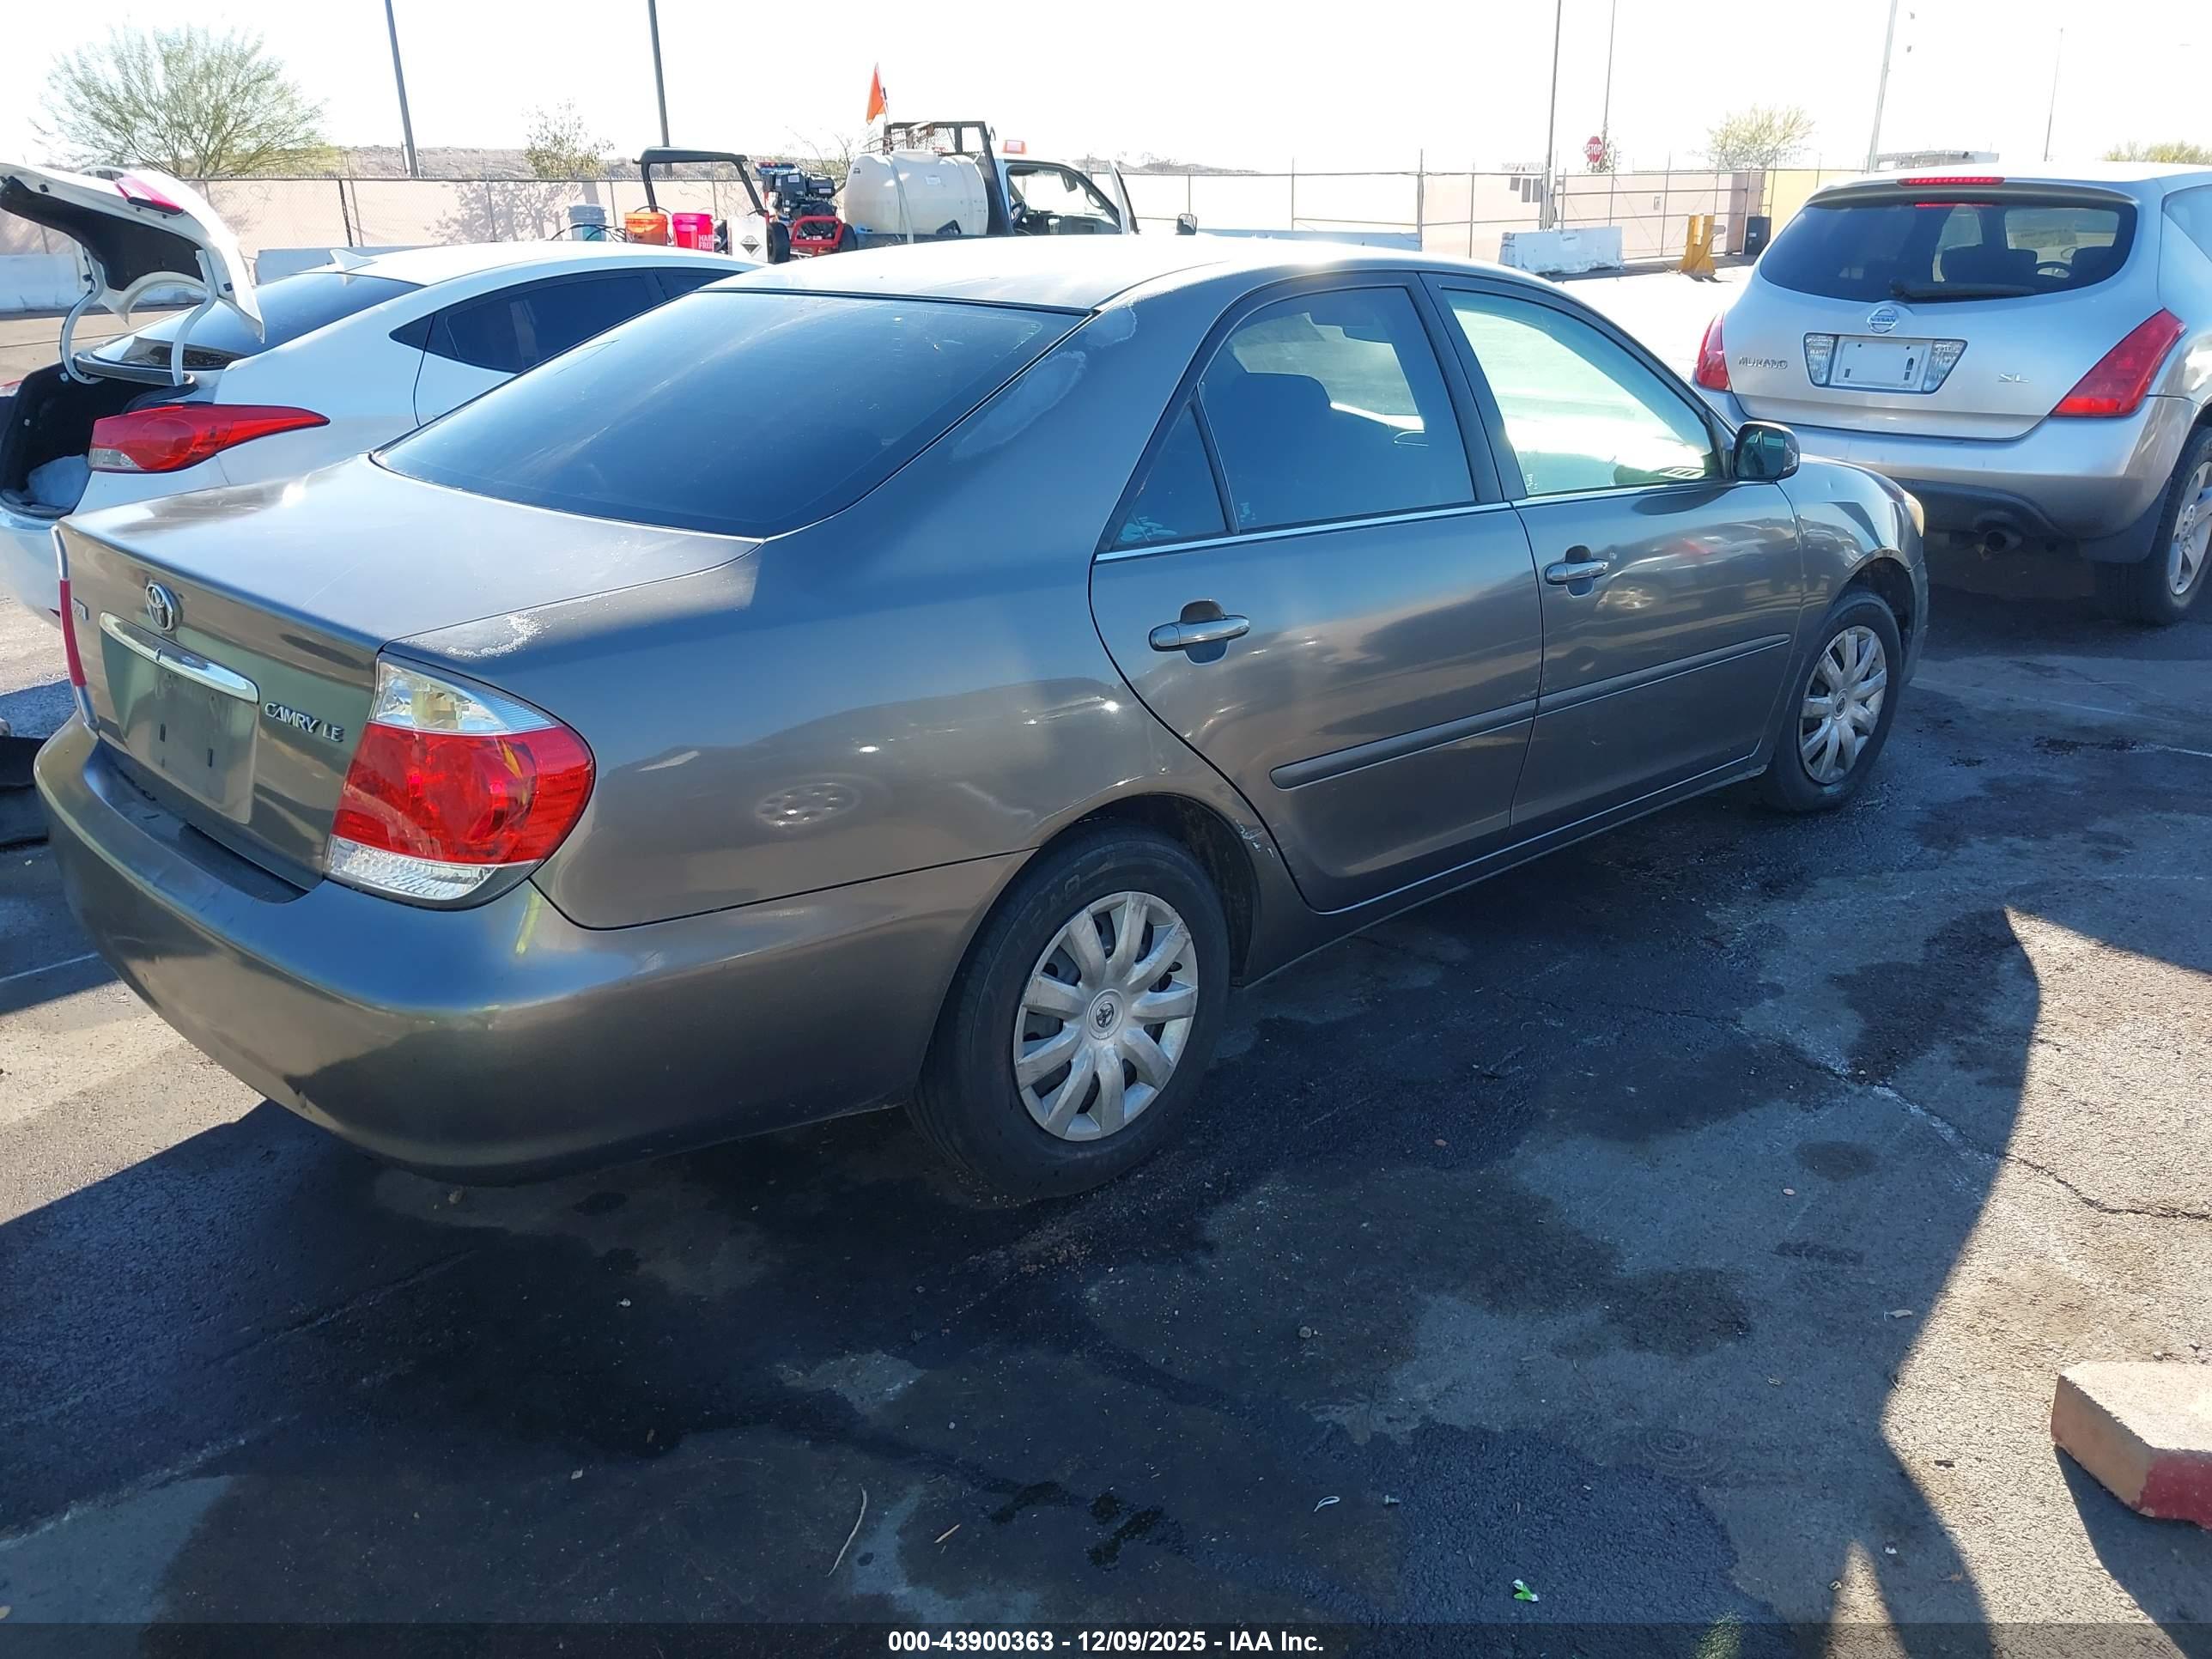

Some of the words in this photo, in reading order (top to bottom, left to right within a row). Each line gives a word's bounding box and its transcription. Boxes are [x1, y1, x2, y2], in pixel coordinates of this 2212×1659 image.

[1587, 143, 1601, 155] STOP
[1739, 356, 1788, 369] MURANO
[1998, 373, 2029, 383] SL
[264, 702, 320, 733] CAMRY
[322, 724, 343, 742] LE
